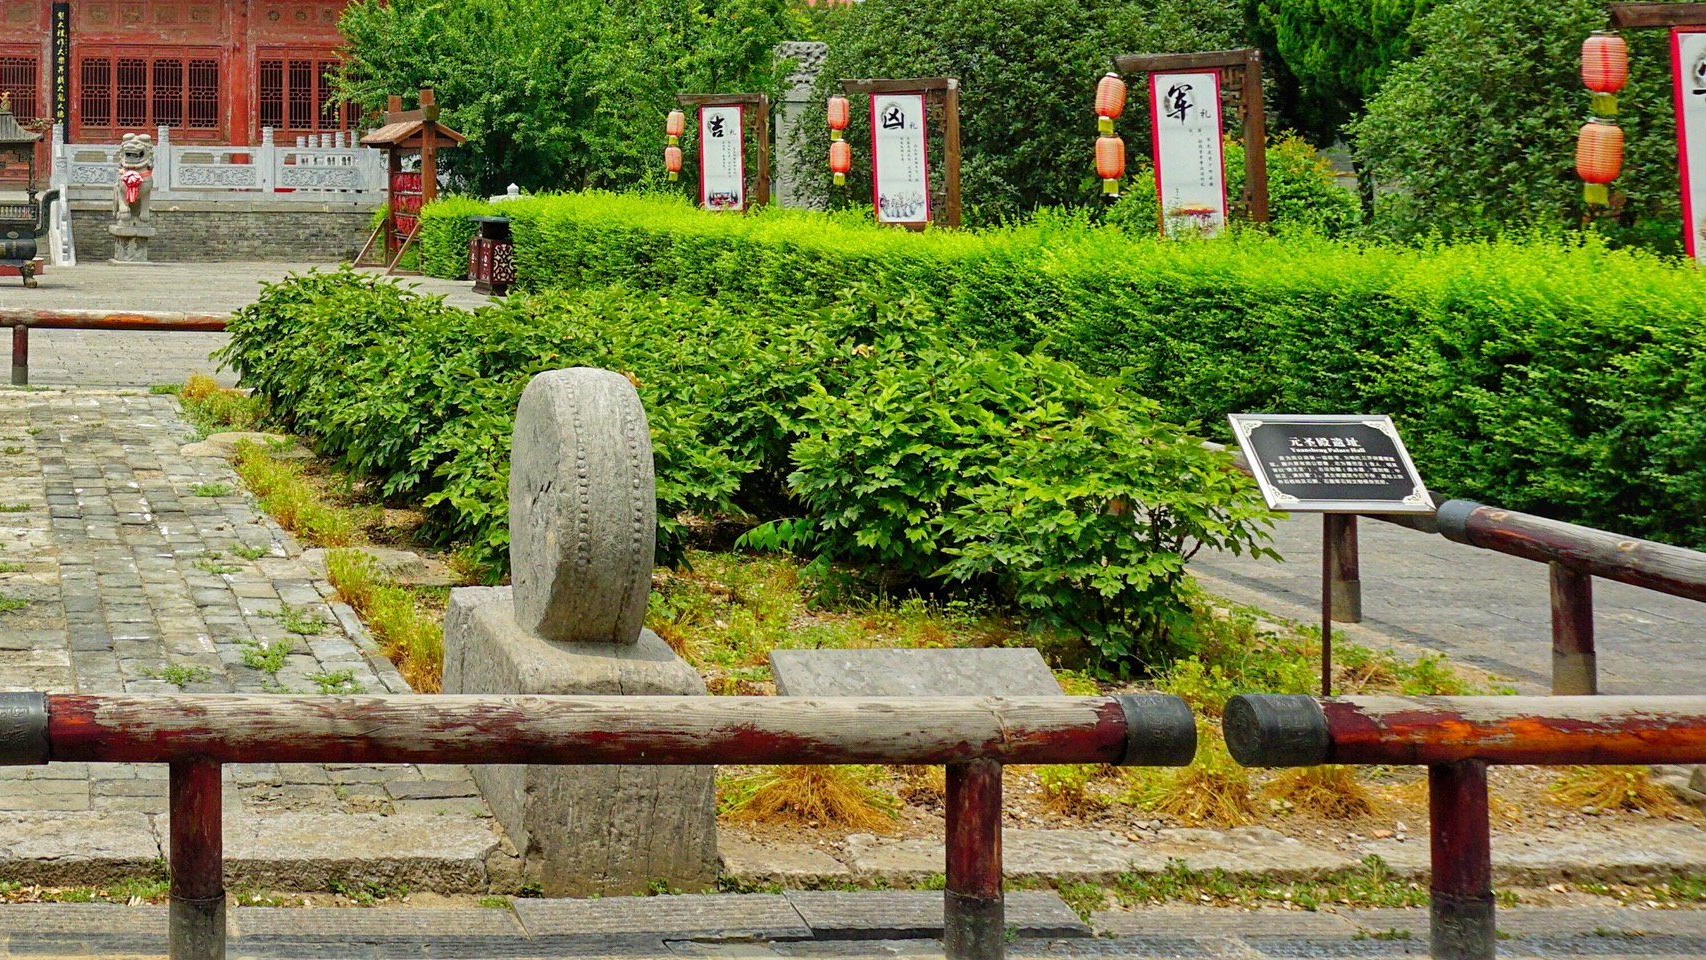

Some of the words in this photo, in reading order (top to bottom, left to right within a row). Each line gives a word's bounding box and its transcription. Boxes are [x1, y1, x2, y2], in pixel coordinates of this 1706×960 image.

[1166, 84, 1193, 126] 军
[709, 115, 725, 138] 吉
[882, 108, 905, 130] 凶
[1288, 436, 1362, 448] 元圣殿遗址
